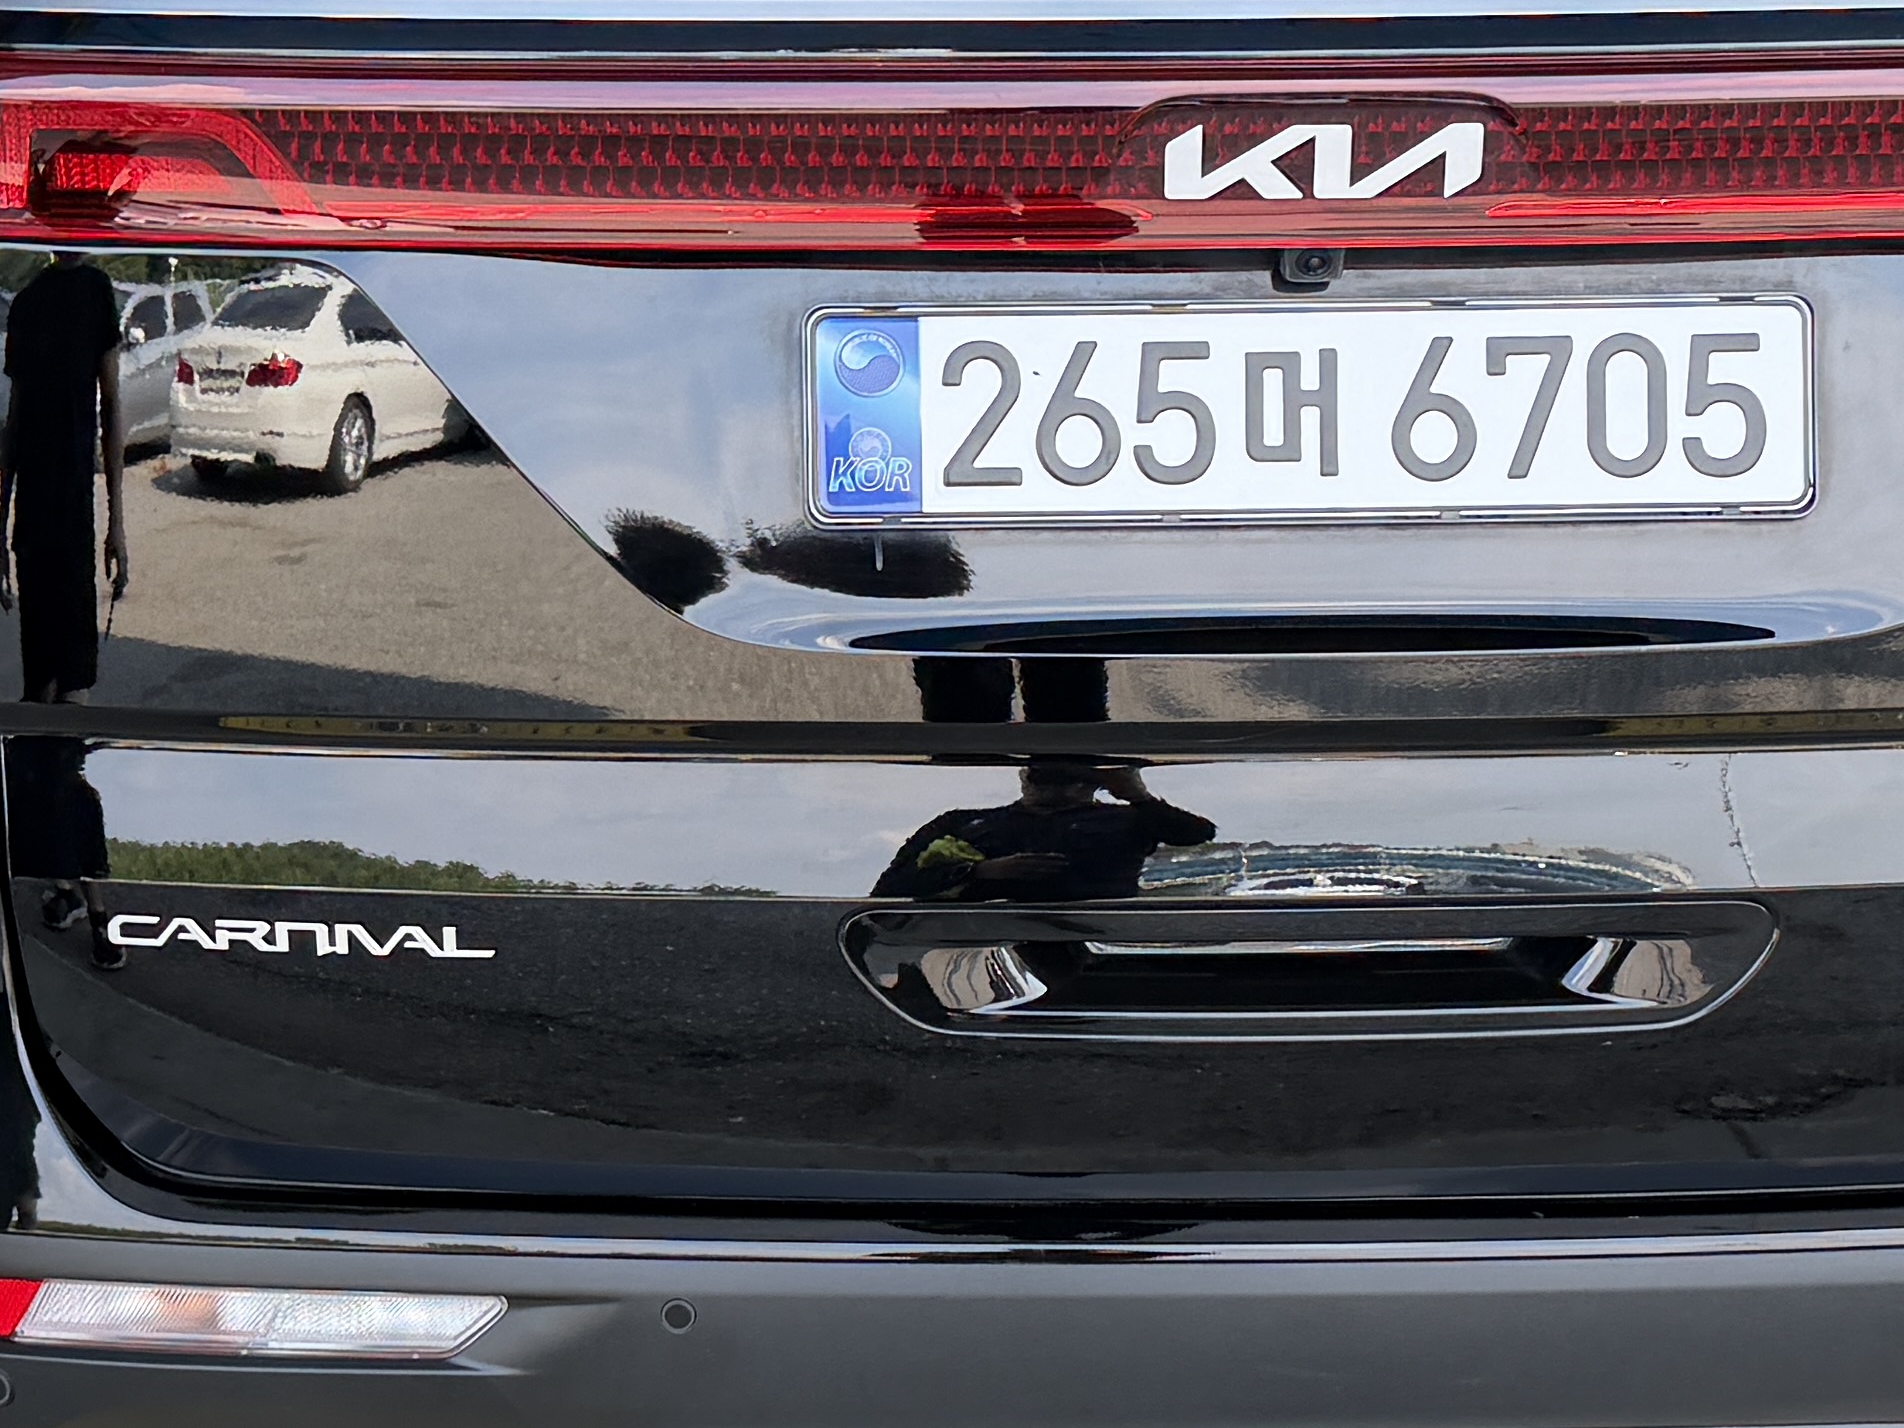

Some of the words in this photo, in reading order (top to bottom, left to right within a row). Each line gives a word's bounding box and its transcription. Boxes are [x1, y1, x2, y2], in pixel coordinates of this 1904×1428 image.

[1161, 122, 1486, 200] KIA
[940, 338, 1339, 488] 265머
[1390, 331, 1767, 483] 6705
[828, 456, 913, 493] KOR
[107, 914, 496, 960] CARNIVAL
